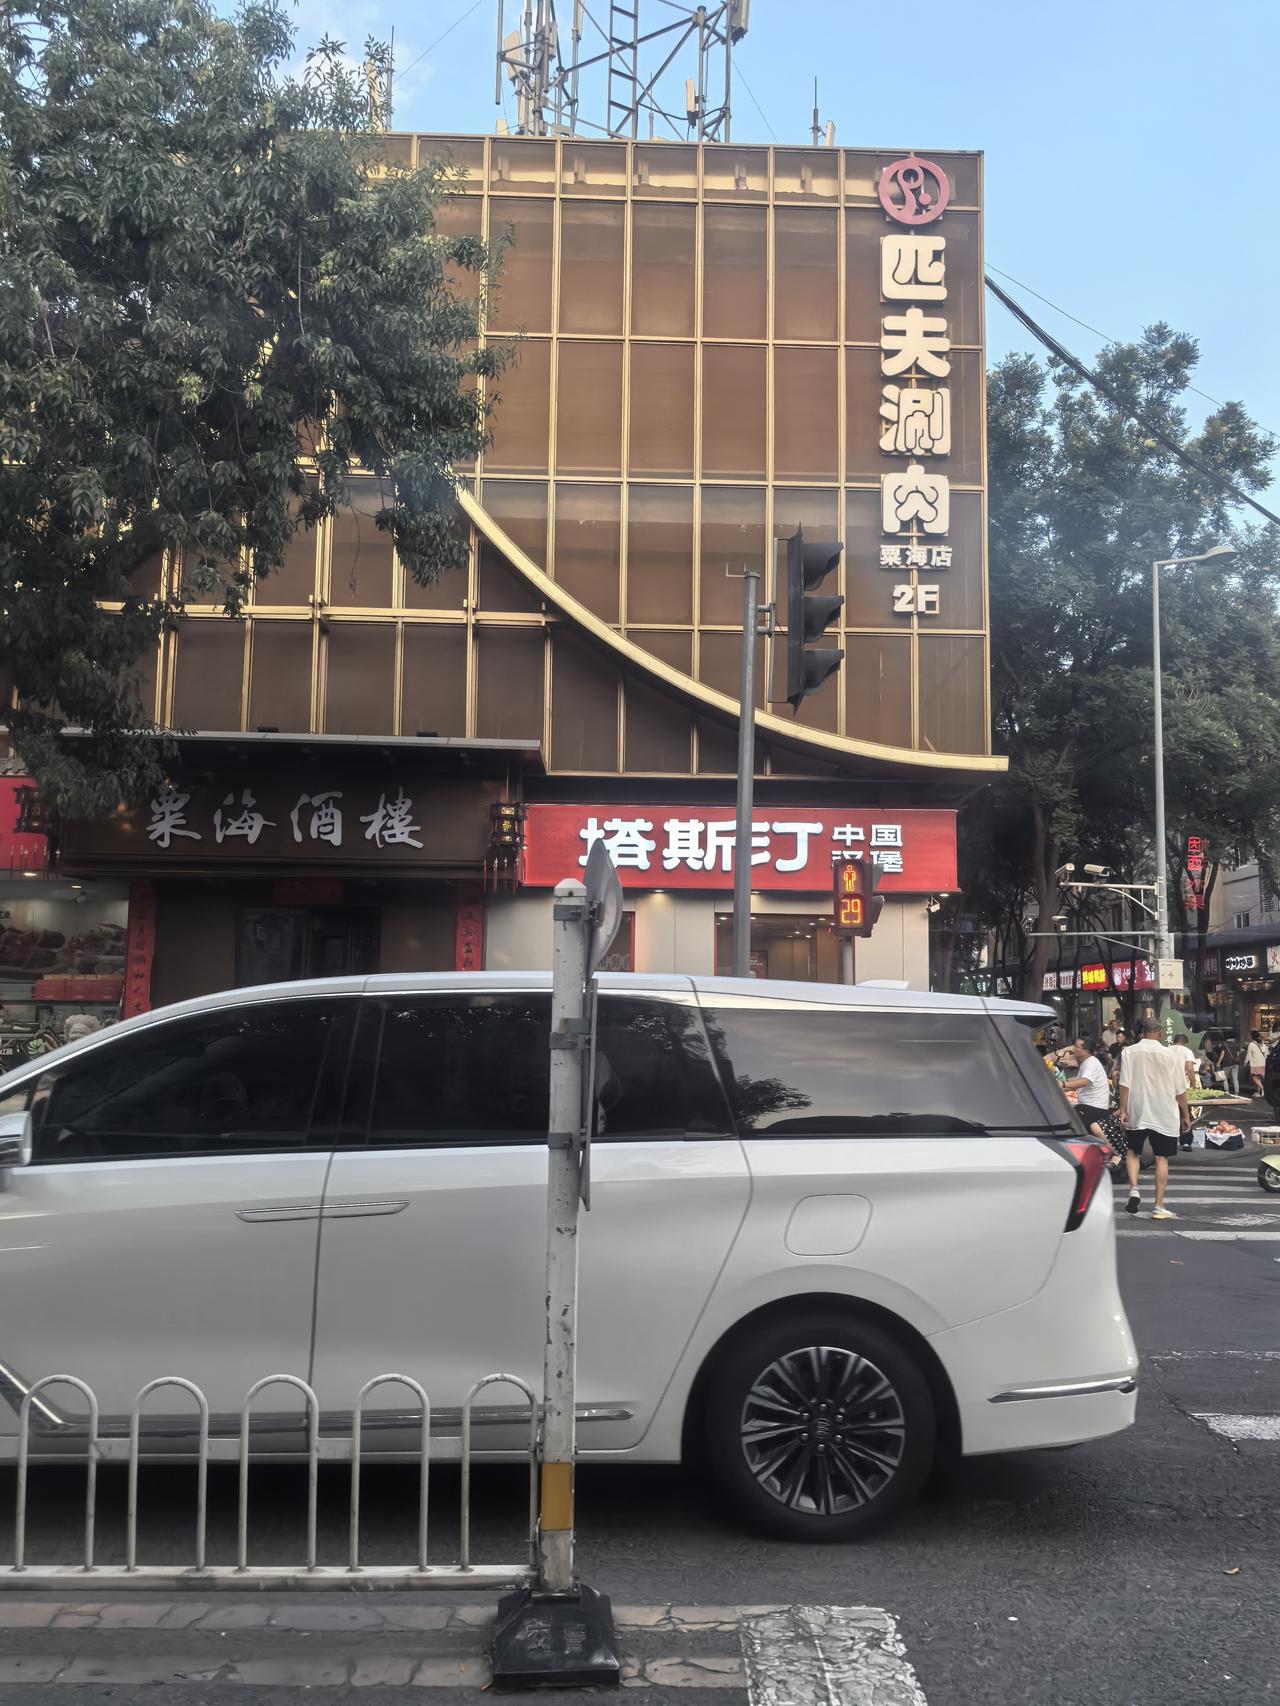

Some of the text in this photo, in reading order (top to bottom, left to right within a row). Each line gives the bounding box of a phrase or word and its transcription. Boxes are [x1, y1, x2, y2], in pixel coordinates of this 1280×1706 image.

[880, 235, 951, 534] 匹夫涮肉
[879, 545, 953, 567] 粟海店
[892, 583, 940, 614] 2F
[578, 817, 823, 872] 塔斯丁
[832, 823, 904, 846] 中国
[841, 898, 861, 924] 29
